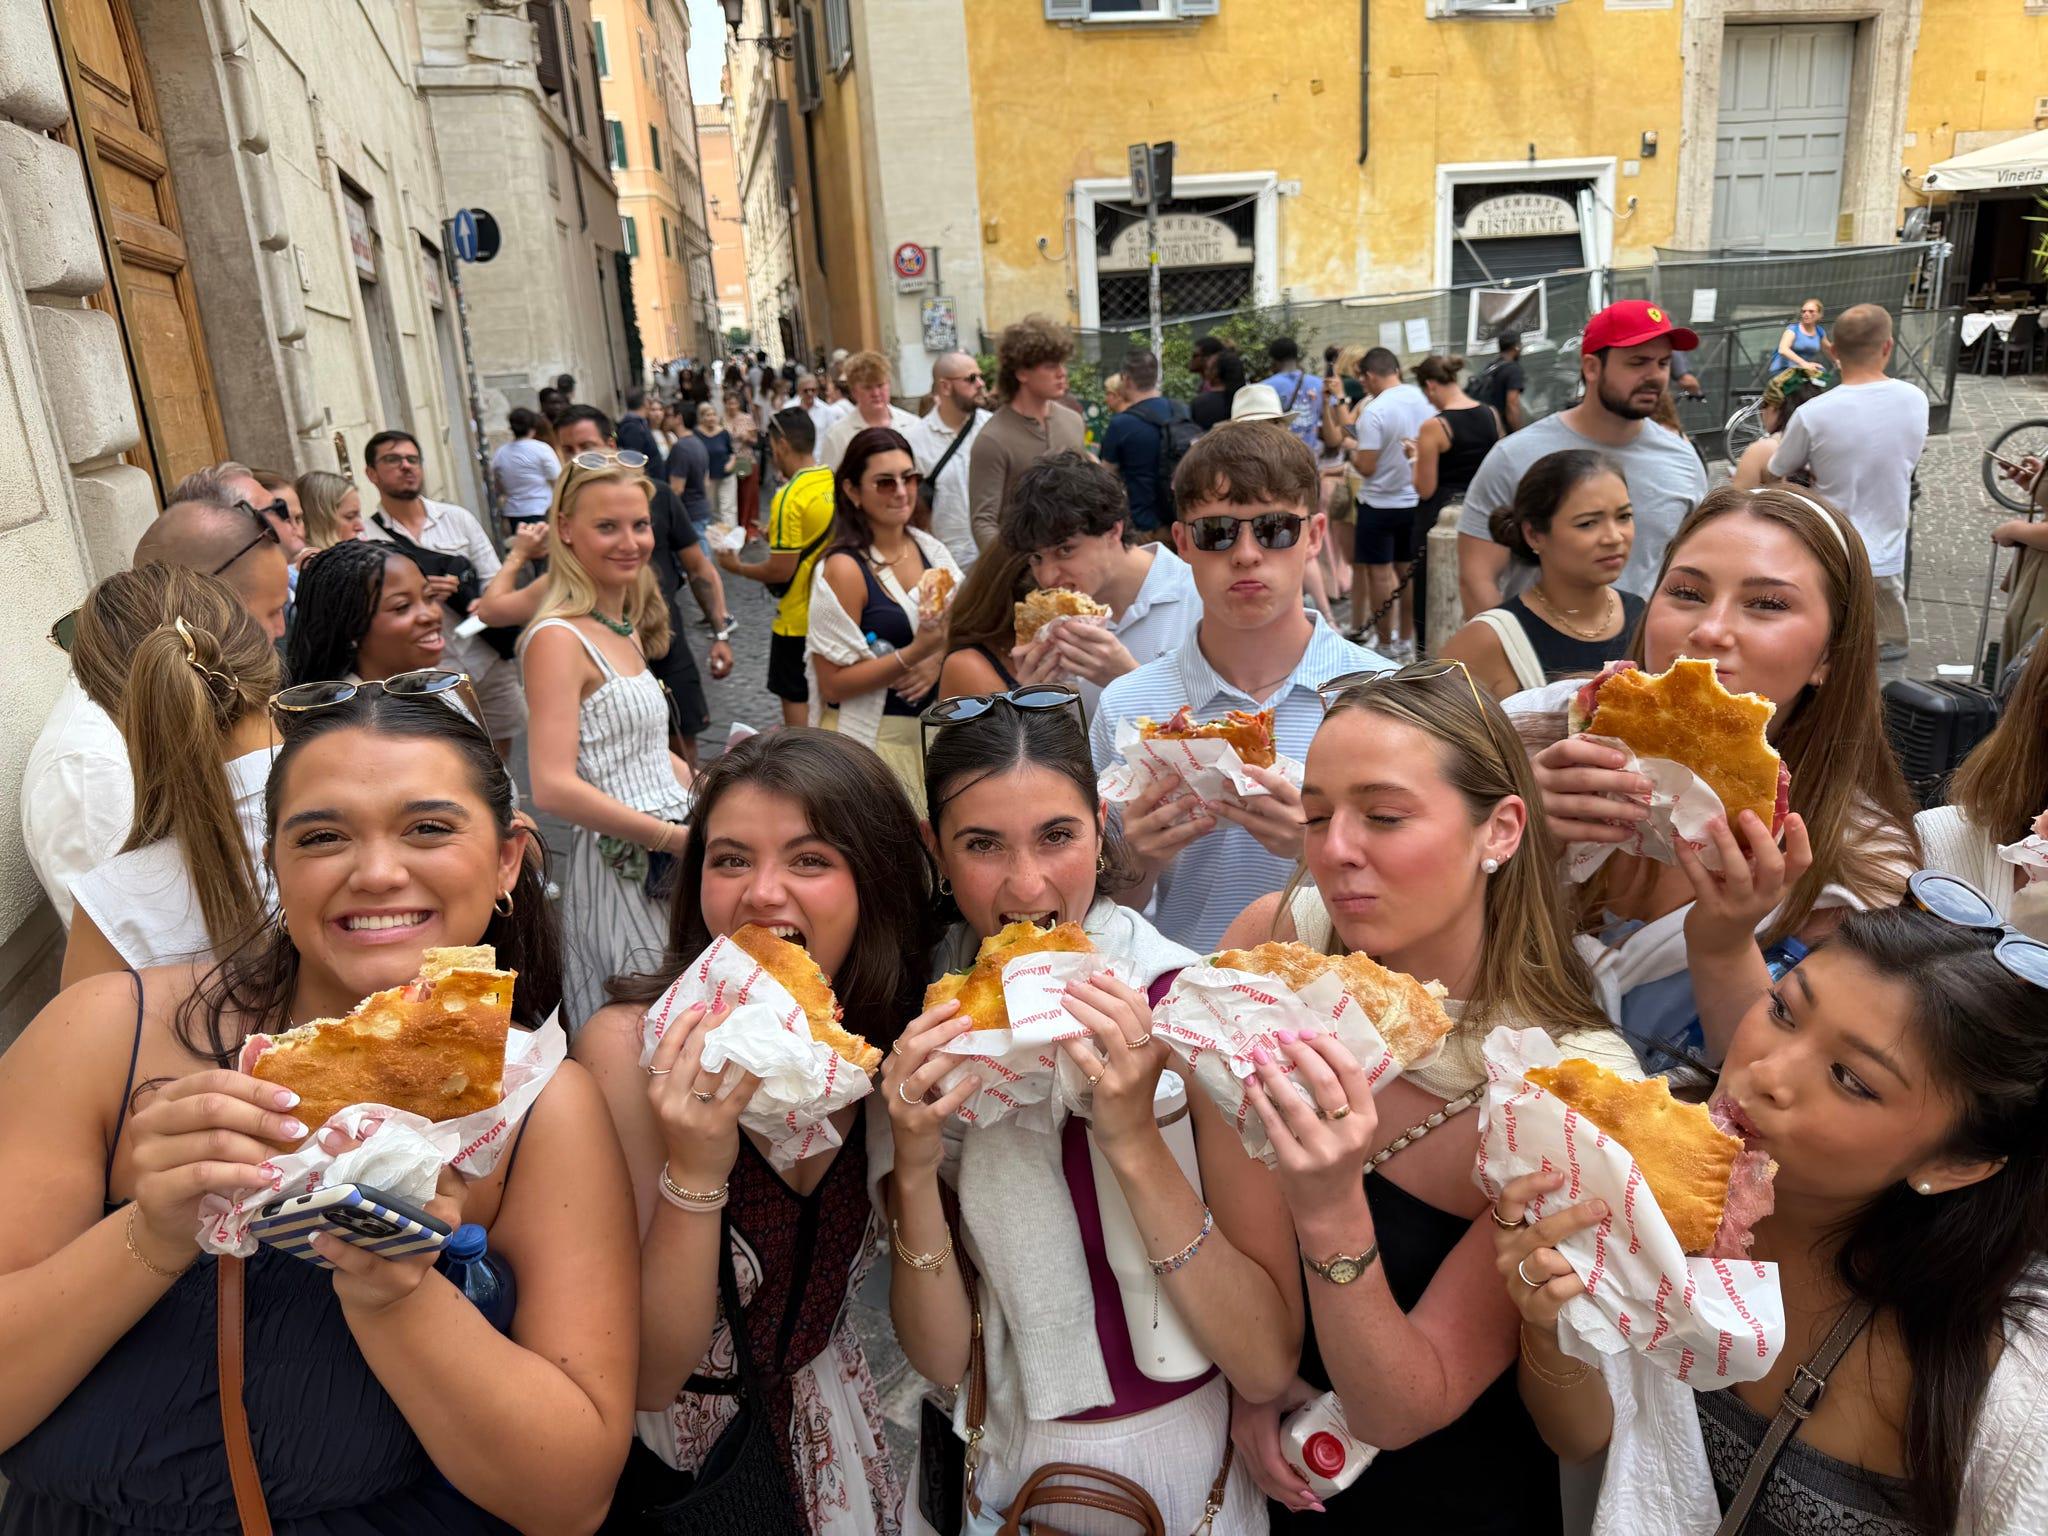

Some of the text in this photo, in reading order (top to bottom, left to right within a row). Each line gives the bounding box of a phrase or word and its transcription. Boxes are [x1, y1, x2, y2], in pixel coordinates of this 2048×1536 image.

[1997, 168, 2043, 183] Vineria
[1477, 215, 1566, 236] RISTORANTE
[698, 936, 726, 984] All'Antico
[738, 966, 763, 1006] ll'Antico
[1231, 984, 1279, 1005] All'Anti
[654, 986, 678, 1039] All'Antico
[1017, 1008, 1062, 1026] All'Antico
[453, 1116, 507, 1165] All'Antico
[1505, 1113, 1518, 1153] Vinaio
[1569, 1159, 1582, 1200] Vinaio
[1710, 1258, 1769, 1357] All'Antico Vinaio
